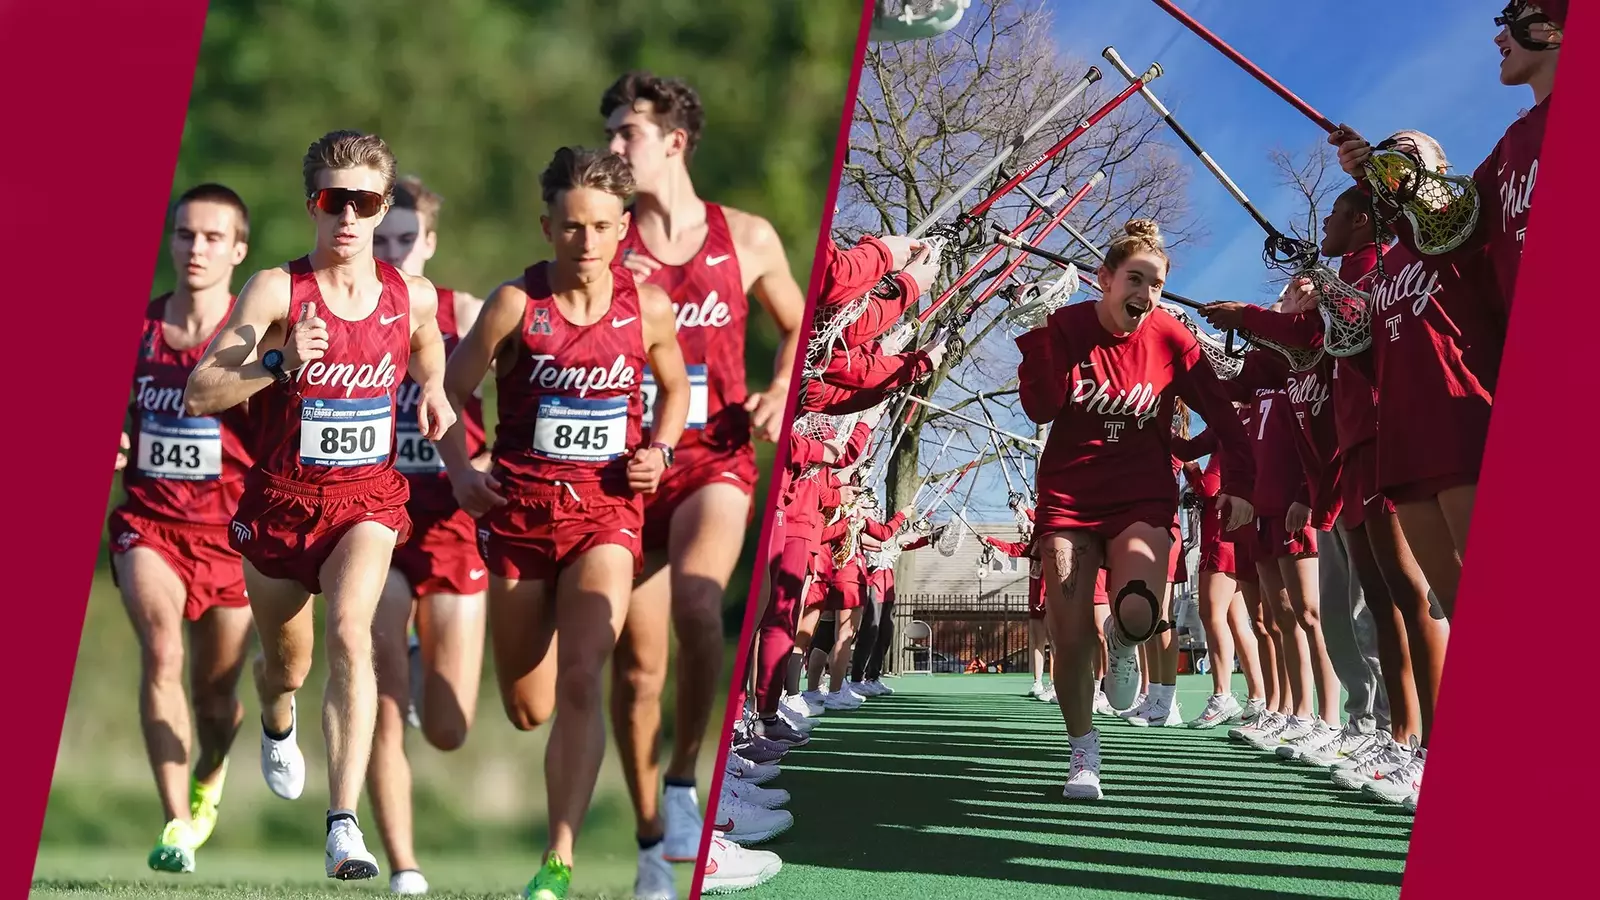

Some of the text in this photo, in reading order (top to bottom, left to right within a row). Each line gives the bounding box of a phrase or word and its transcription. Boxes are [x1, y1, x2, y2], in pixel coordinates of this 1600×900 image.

[1500, 159, 1538, 233] Phil
[1370, 260, 1442, 317] Philly
[672, 290, 732, 333] ple
[137, 375, 186, 419] Tem
[530, 354, 635, 398] Temple
[1070, 379, 1161, 429] Philly
[1257, 399, 1273, 440] 7
[150, 441, 200, 468] 843
[320, 426, 376, 454] 850
[400, 438, 434, 462] 46
[554, 425, 609, 450] 845
